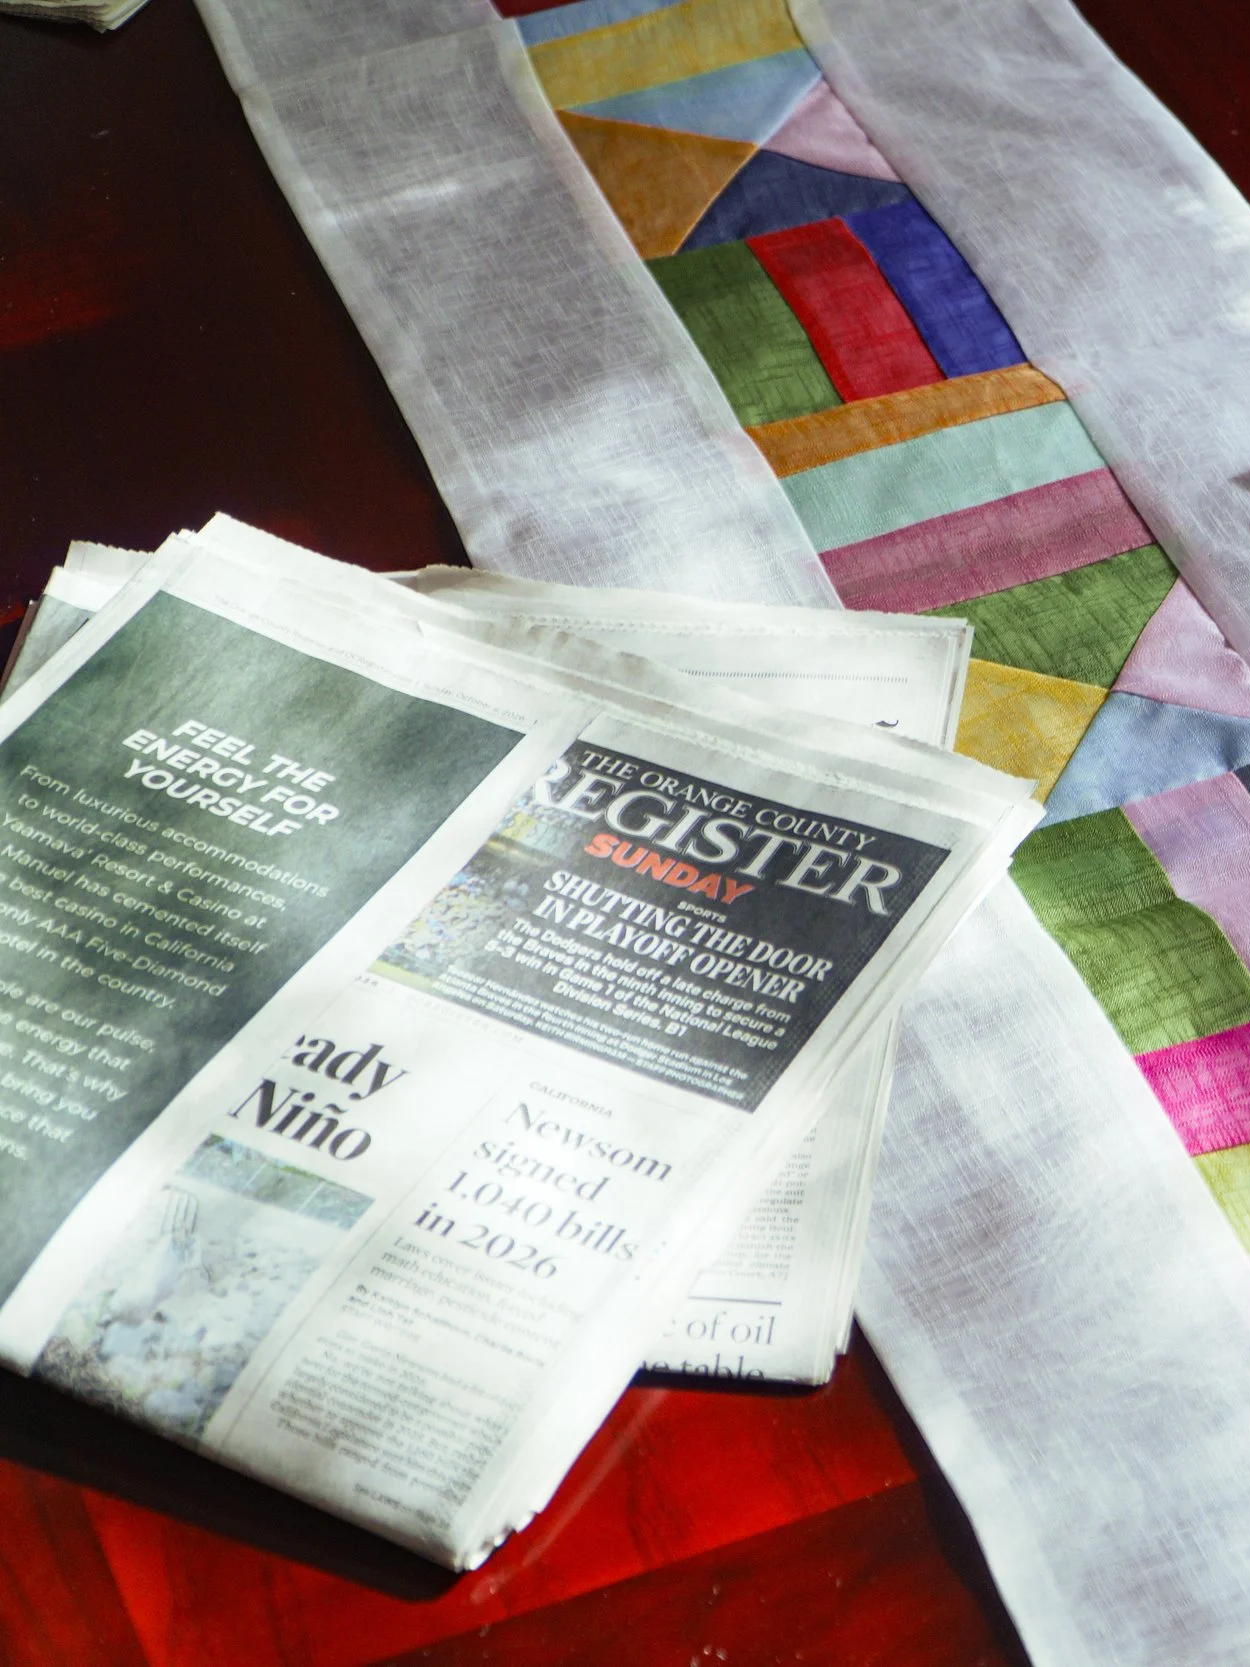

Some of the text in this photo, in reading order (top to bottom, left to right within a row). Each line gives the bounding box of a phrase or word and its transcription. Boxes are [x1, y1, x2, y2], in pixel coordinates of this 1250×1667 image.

[123, 729, 338, 824] ENERGY FOR
[172, 720, 334, 791] FEEL THE
[19, 764, 328, 896] From luxurious accommodations
[125, 758, 301, 835] YOURSELF
[581, 750, 875, 859] THE ORANGE COUNTY
[17, 793, 285, 911] to world-class performances,
[531, 757, 903, 914] REGISTER
[584, 834, 752, 903] SUNDAY
[0, 843, 269, 954] Manuel has cemented itself
[8, 876, 234, 972] best casino in California
[91, 854, 155, 886] Resort
[157, 880, 173, 893] &
[176, 888, 243, 919] Casino
[243, 915, 266, 928] at
[544, 871, 832, 980] SHUTTING THE DOOR
[677, 901, 726, 922] SPORTS
[36, 918, 81, 943] AAA
[85, 935, 226, 996] Five-Diamond
[36, 947, 57, 961] in
[60, 956, 93, 976] the
[97, 974, 174, 1009] country.
[497, 929, 522, 945] the
[523, 938, 579, 965] Braves
[574, 958, 590, 971] in
[591, 964, 617, 980] the
[616, 975, 656, 995] ninth
[657, 988, 703, 1013] inning
[706, 1004, 722, 1016] to
[723, 1011, 773, 1031] secure
[513, 917, 540, 936] The
[536, 929, 601, 960] Dodgers
[602, 952, 638, 972] hold
[636, 967, 662, 980] off
[672, 977, 701, 994] late
[702, 990, 753, 1010] charge
[755, 1003, 790, 1022] from
[533, 895, 804, 1002] IN PLAYOFF OPENER
[25, 995, 153, 1052] are our pulse,
[471, 996, 486, 1005] on
[484, 939, 515, 957] 5-3
[515, 953, 541, 968] win
[542, 961, 558, 975] in
[559, 968, 602, 991] Game
[613, 990, 633, 1001] of
[632, 995, 658, 1011] the
[659, 1004, 723, 1031] National
[722, 1024, 777, 1049] League
[552, 981, 686, 1036] Division Series. B1
[15, 1020, 85, 1054] energy
[87, 1047, 130, 1070] that
[522, 1005, 540, 1016] the
[541, 1011, 574, 1029] fourth
[606, 1037, 619, 1046] at
[619, 1041, 656, 1059] Dodger
[657, 1055, 701, 1073] Stadium
[712, 1073, 732, 1085] Los
[640, 1038, 670, 1053] home
[670, 1050, 688, 1059] run
[689, 1056, 728, 1073] against
[729, 1068, 747, 1079] the
[0, 1072, 55, 1104] bring
[53, 1097, 96, 1120] you
[82, 1075, 125, 1100] why
[227, 1077, 373, 1163] Niño
[528, 1081, 613, 1119] CALIFORNIA
[27, 1115, 71, 1142] that
[503, 1099, 674, 1184] Newsom
[472, 1140, 611, 1201] signed
[414, 1202, 557, 1277] in 2026
[447, 1170, 637, 1259] 1,040 bills
[393, 1236, 428, 1257] Laws
[431, 1255, 470, 1273] cover
[473, 1270, 512, 1292] issues
[685, 1306, 776, 1345] of oil
